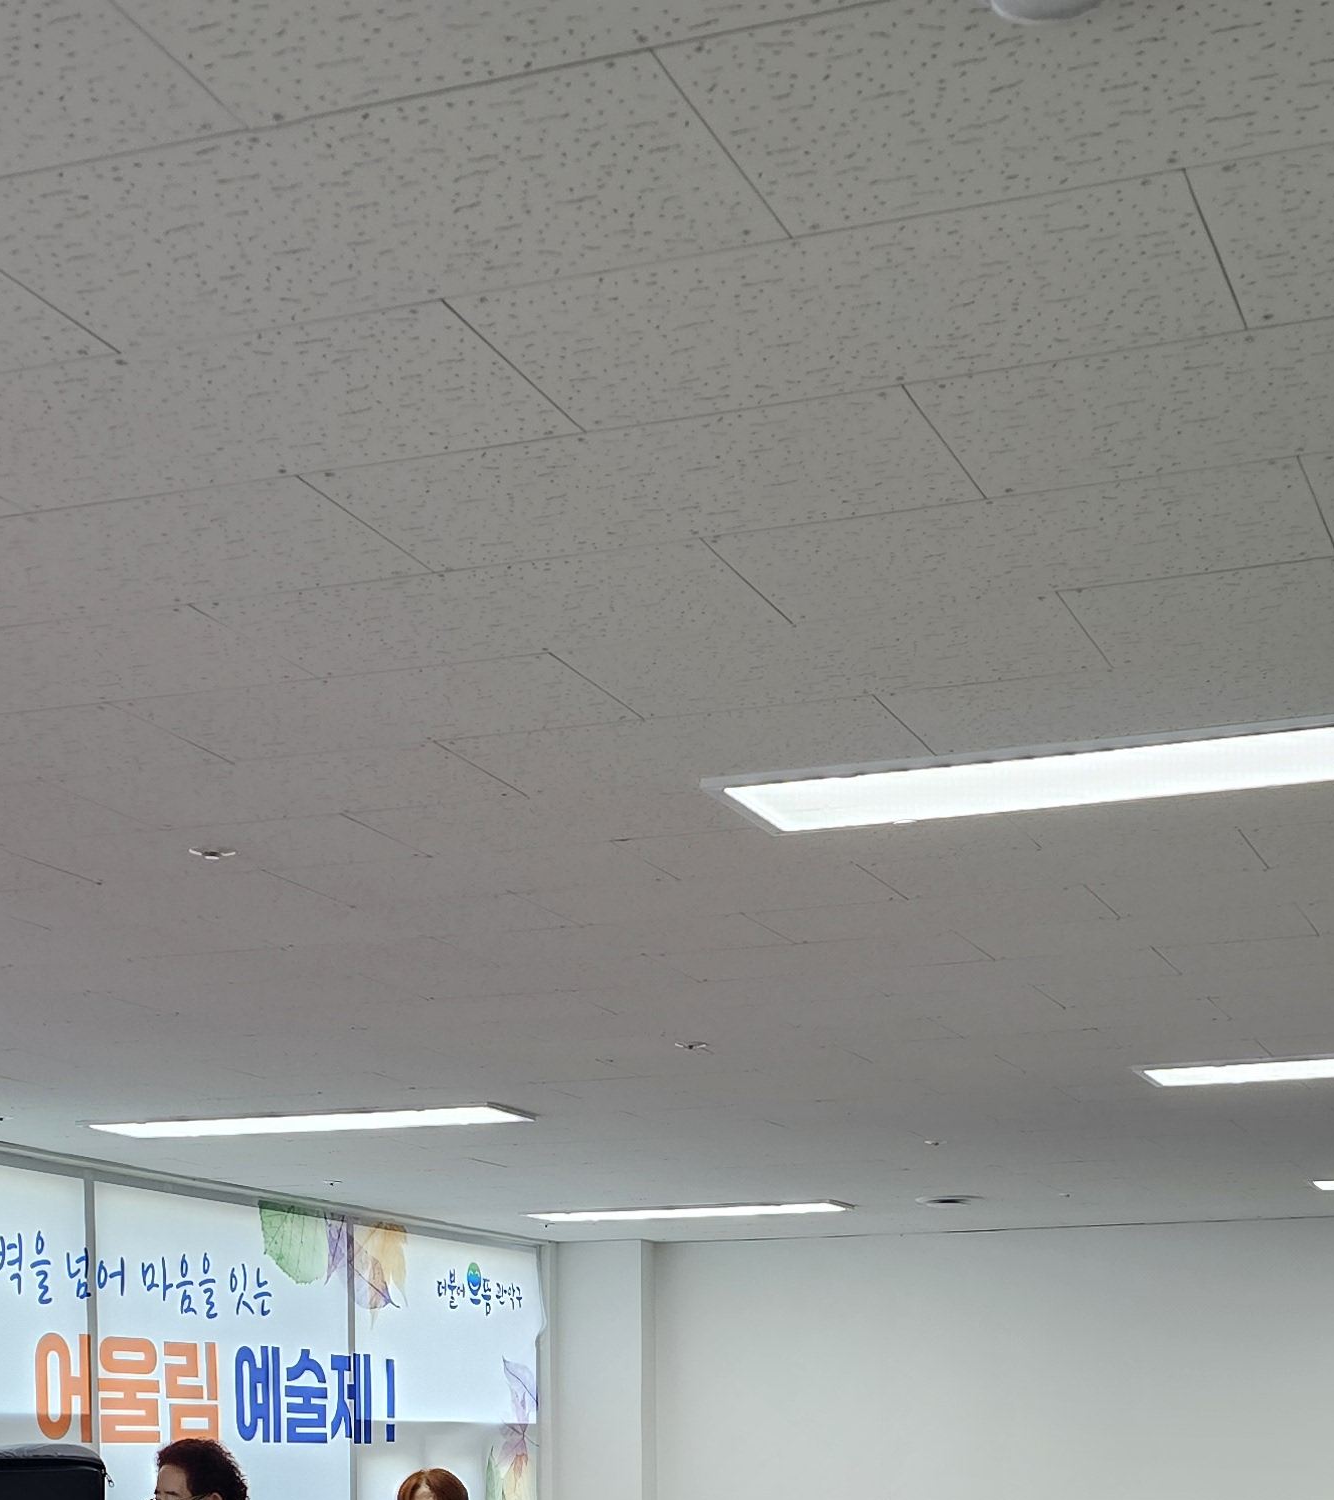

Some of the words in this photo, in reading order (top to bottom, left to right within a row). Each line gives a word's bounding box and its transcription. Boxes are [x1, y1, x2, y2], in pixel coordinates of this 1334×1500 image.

[66, 1247, 125, 1299] 넘어
[141, 1253, 219, 1318] 마음을
[229, 1262, 273, 1317] 잇는
[436, 1269, 465, 1309] 더불어
[35, 1332, 220, 1443] 어울림
